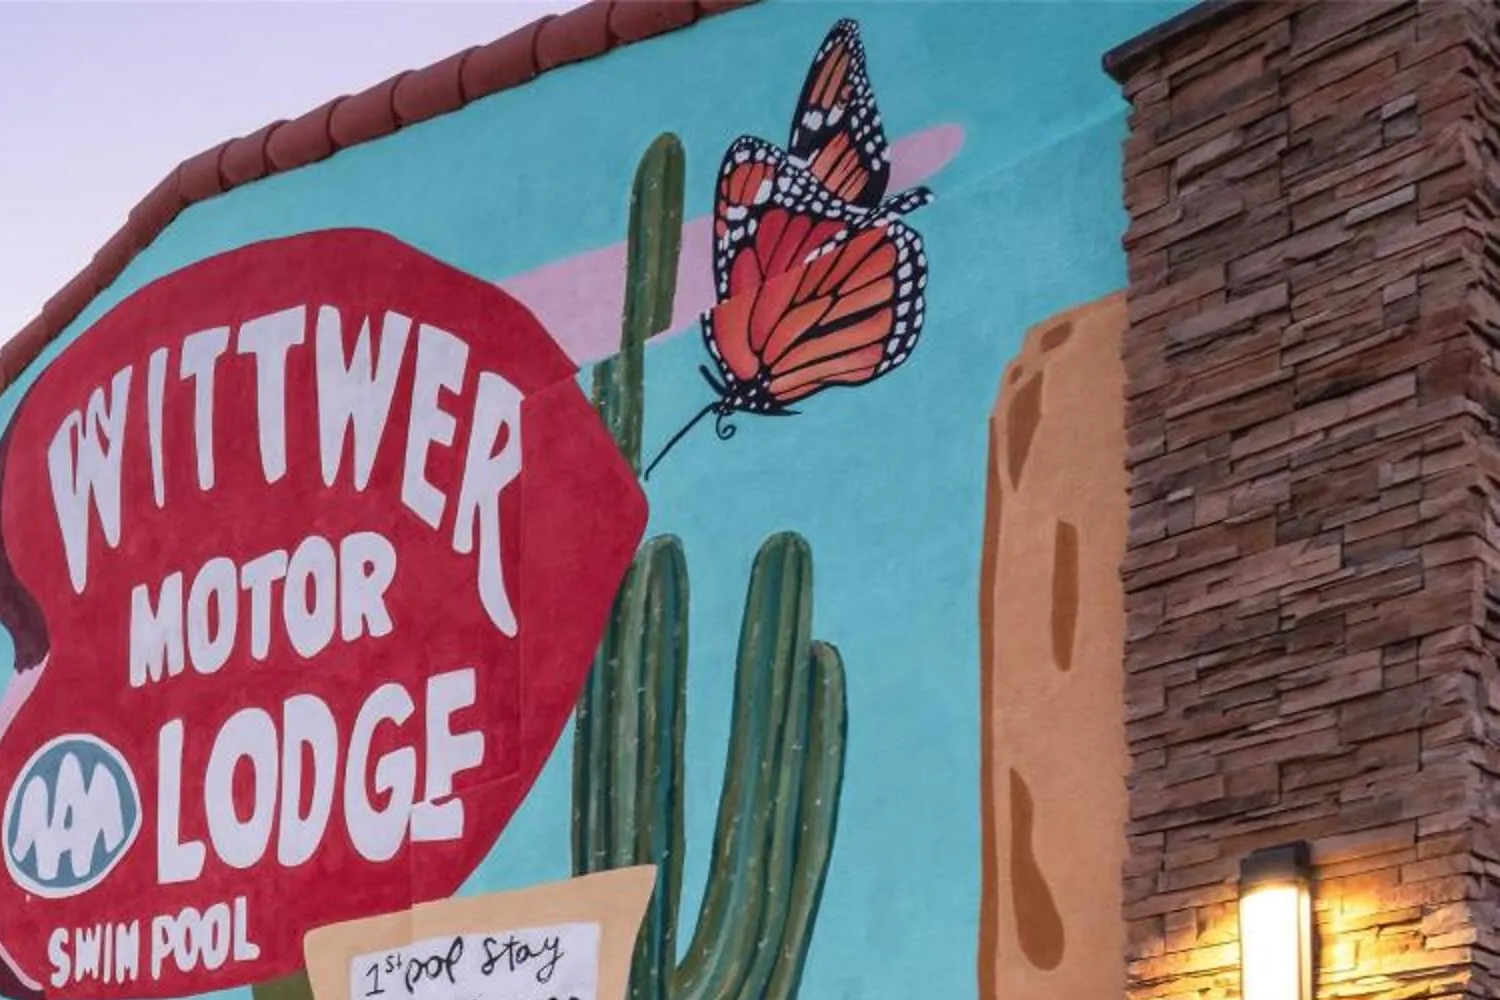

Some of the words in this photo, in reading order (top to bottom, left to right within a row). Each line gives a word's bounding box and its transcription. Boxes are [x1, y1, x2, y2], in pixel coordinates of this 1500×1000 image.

[47, 304, 525, 637] WITTWER
[129, 531, 397, 688] MOTOR
[157, 668, 485, 885] LODGE
[47, 920, 141, 988] SWIM
[151, 896, 261, 981] POOL
